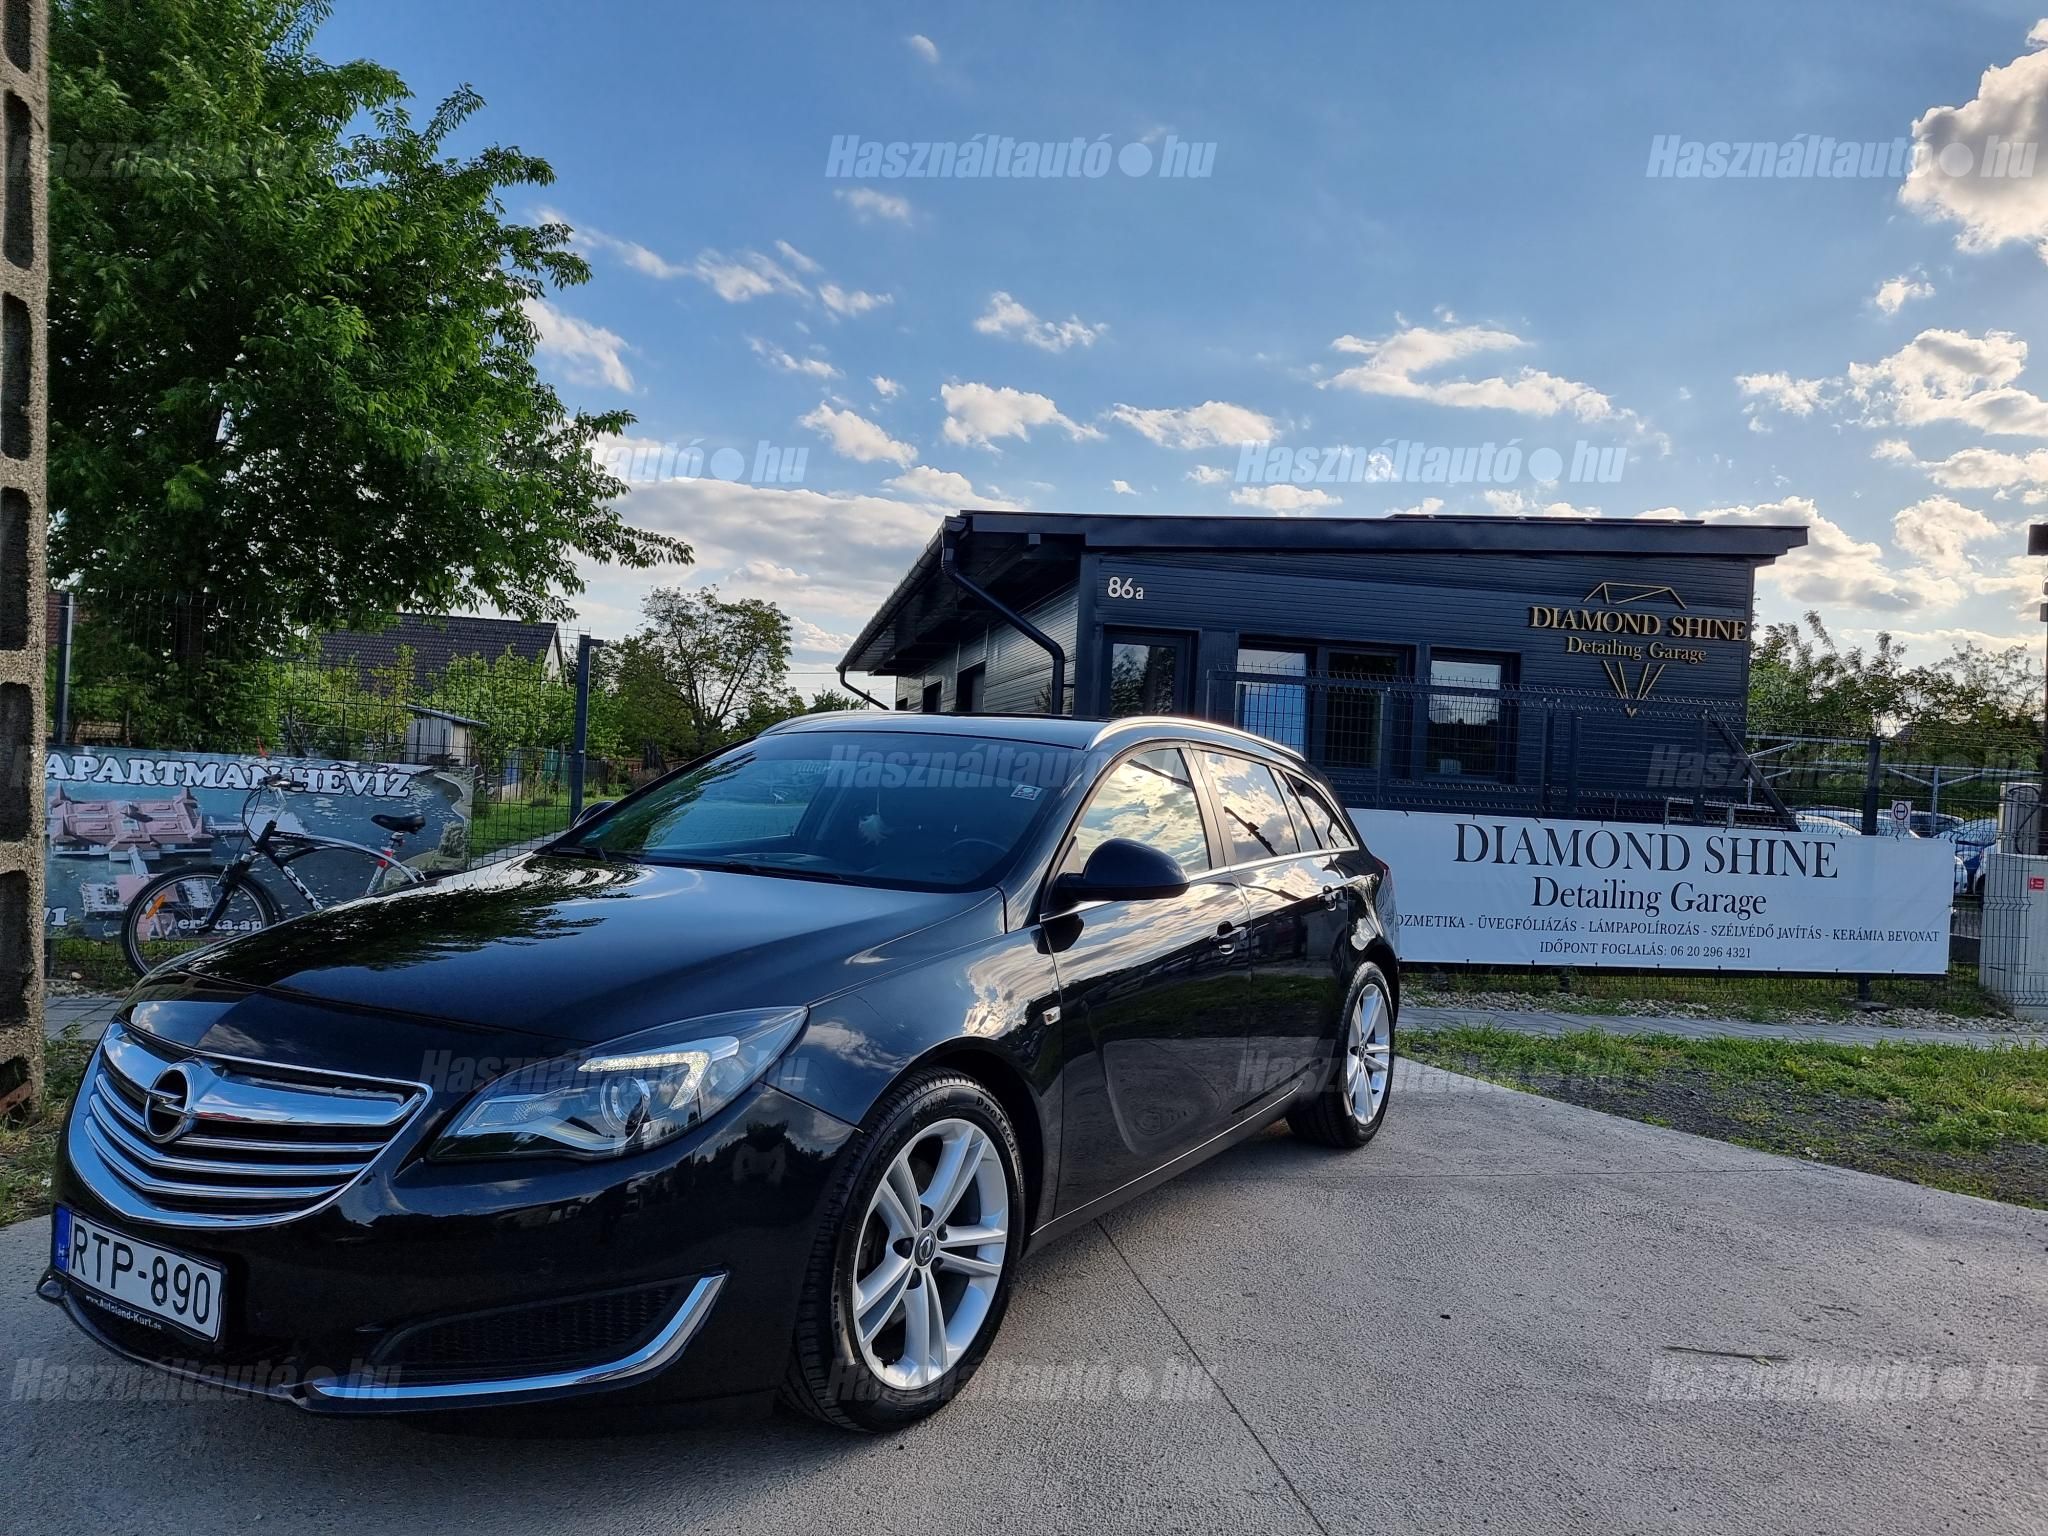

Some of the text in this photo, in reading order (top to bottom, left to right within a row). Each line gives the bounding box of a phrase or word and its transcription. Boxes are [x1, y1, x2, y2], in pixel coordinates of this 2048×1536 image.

[1107, 576, 1144, 600] 86a
[1529, 606, 1748, 641] DIAMOND SHINE
[1567, 636, 1707, 664] Detailing Garage
[45, 753, 412, 798] APARTMAN HÉVÍZ
[1452, 823, 1839, 879] DIAMOND SHINE
[1531, 876, 1767, 921] Detailing Garage
[1478, 916, 1577, 932] ÜVEGFÓLIÁZÁS
[1589, 918, 1700, 936] LÁMPAPOLÍROZÁS
[1711, 923, 1774, 938] SZÉLVÉDŐ
[1776, 925, 1822, 940] JAVÍTÁS
[1833, 927, 1885, 942] KERÁMIA
[1887, 930, 1940, 943] BEVONAT
[1539, 939, 1751, 959] IDŐPONT FOGLALÁS: 06 20 296 4321
[72, 1223, 211, 1325] RTP-890
